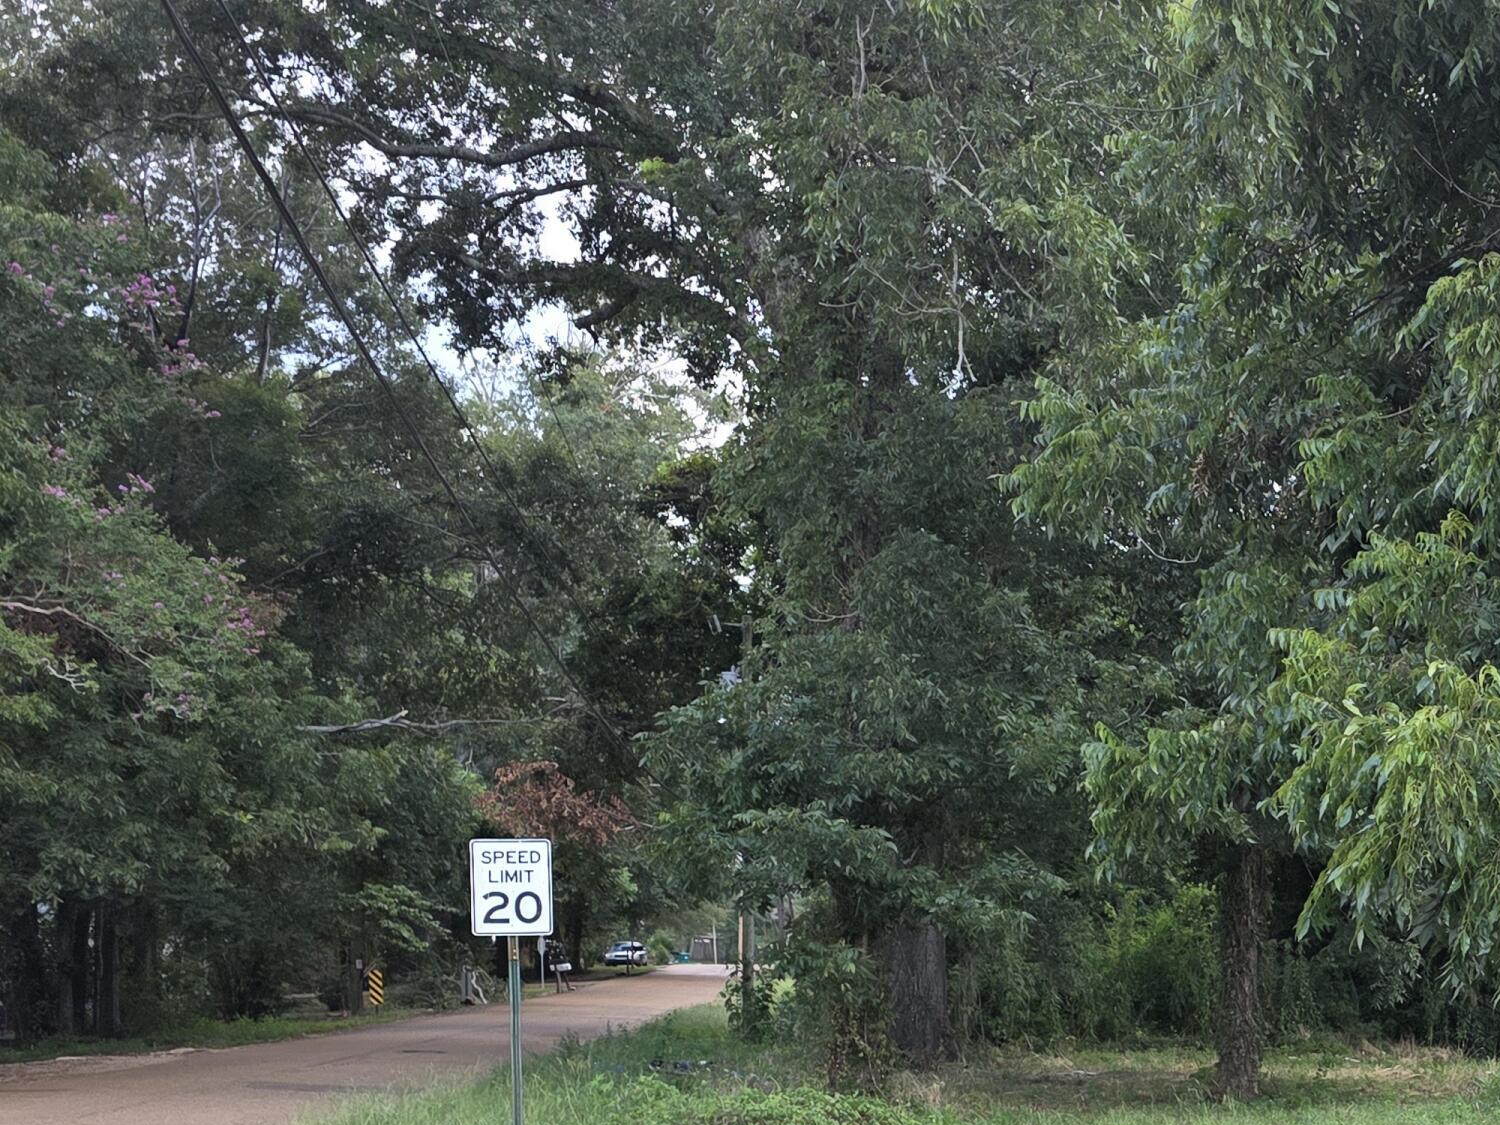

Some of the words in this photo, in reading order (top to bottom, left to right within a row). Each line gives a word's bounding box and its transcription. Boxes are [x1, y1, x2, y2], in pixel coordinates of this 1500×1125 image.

[481, 850, 541, 864] SPEED
[488, 869, 534, 883] LIMIT
[482, 891, 542, 924] 20
